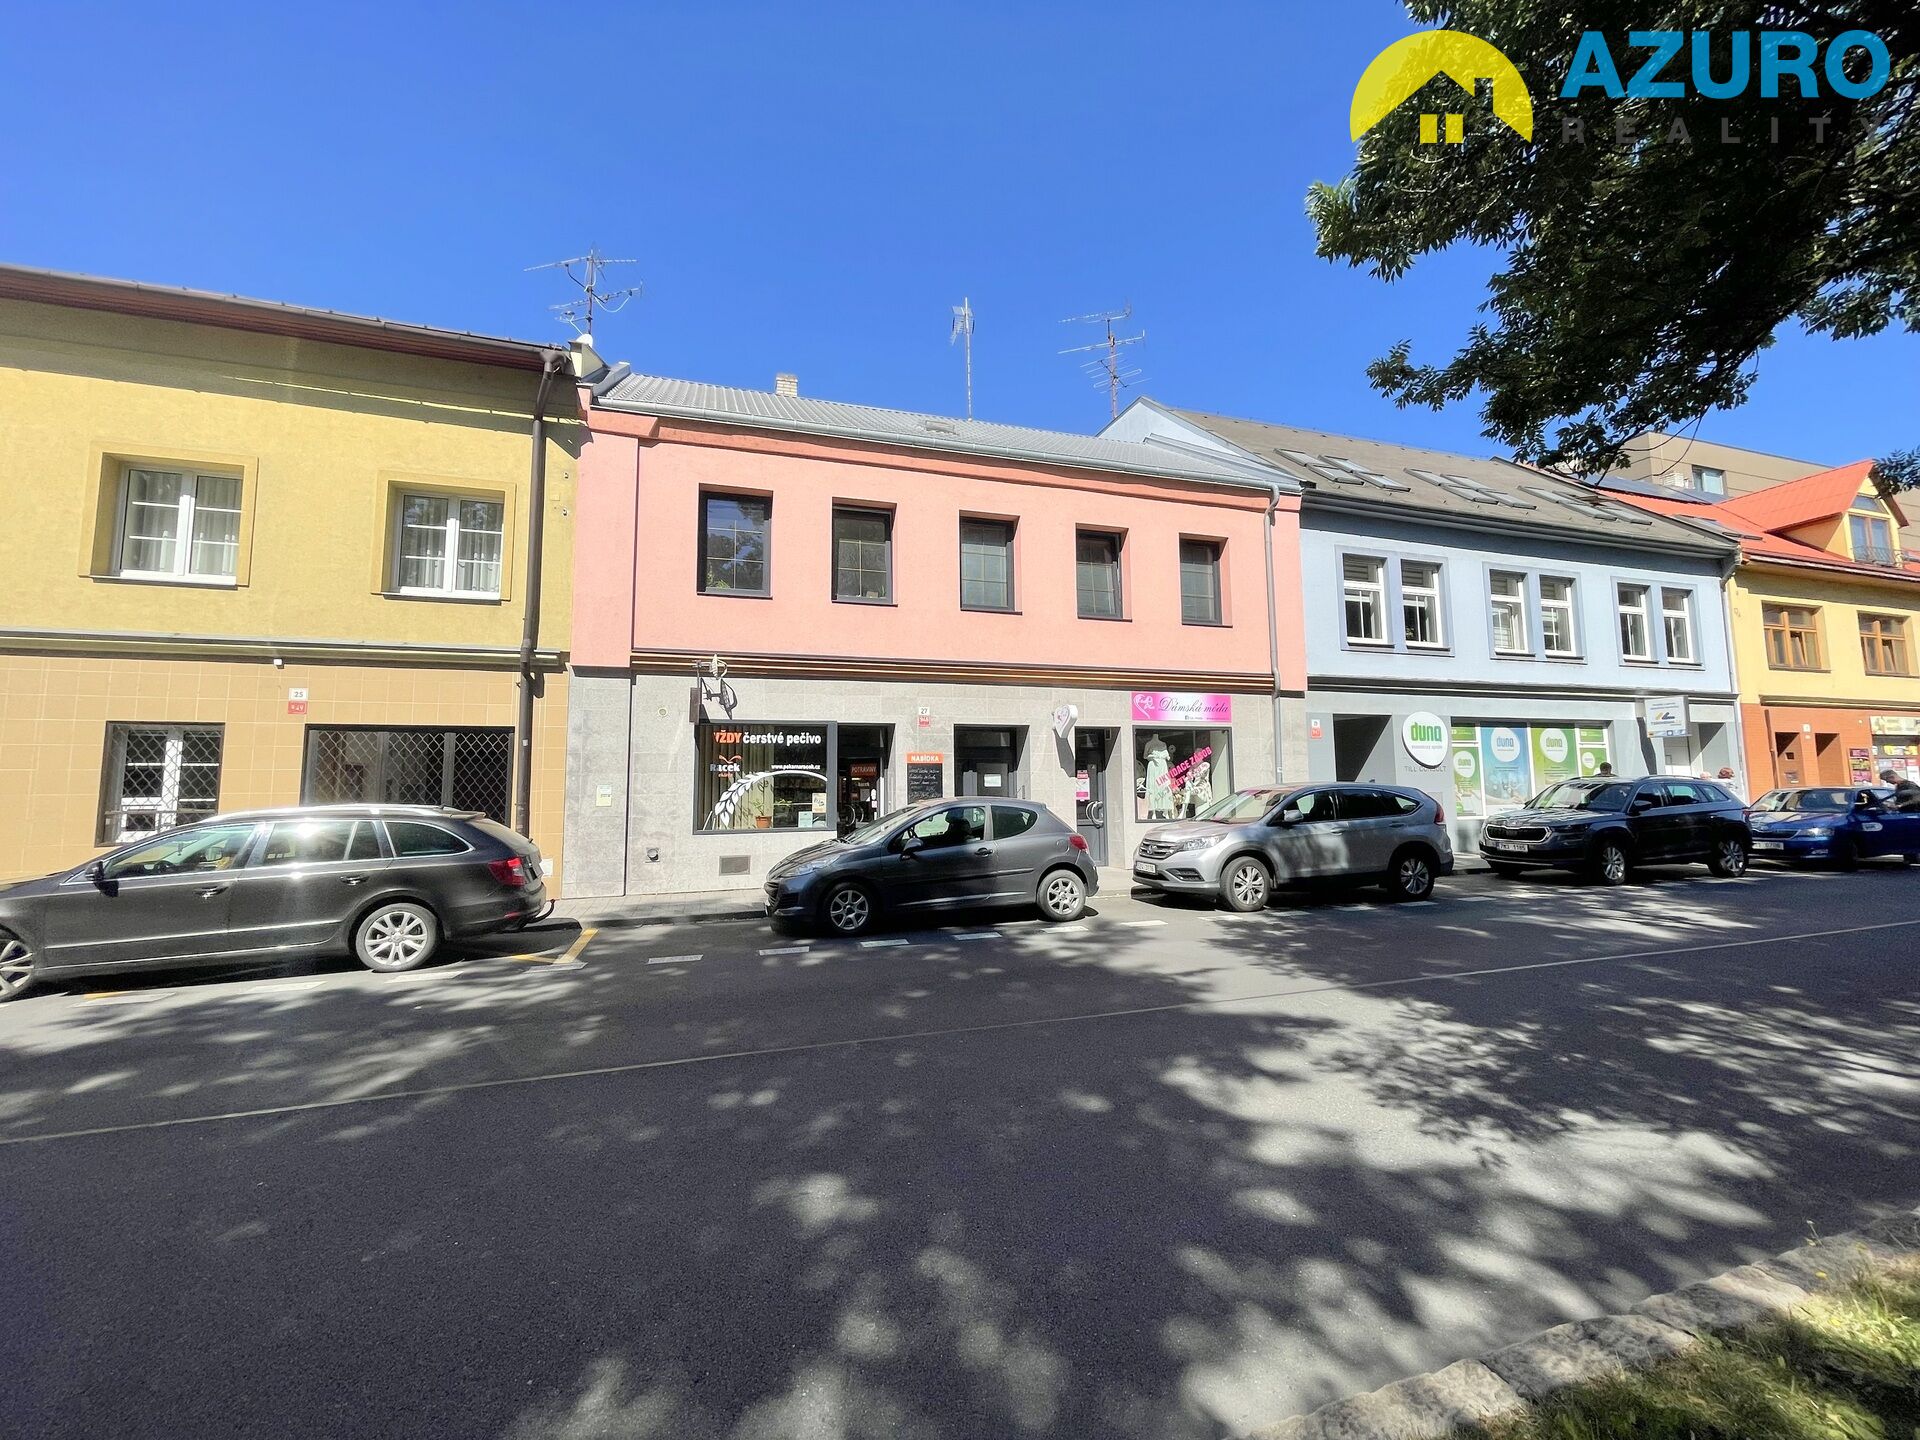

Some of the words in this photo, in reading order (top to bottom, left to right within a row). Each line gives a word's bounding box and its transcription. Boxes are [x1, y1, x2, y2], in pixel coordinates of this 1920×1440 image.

[743, 732, 784, 744] čerstvé
[786, 732, 822, 746] pečivo
[1411, 722, 1442, 741] duna
[851, 765, 877, 773] POTRAVINY
[1156, 760, 1191, 787] LIKVIDACE
